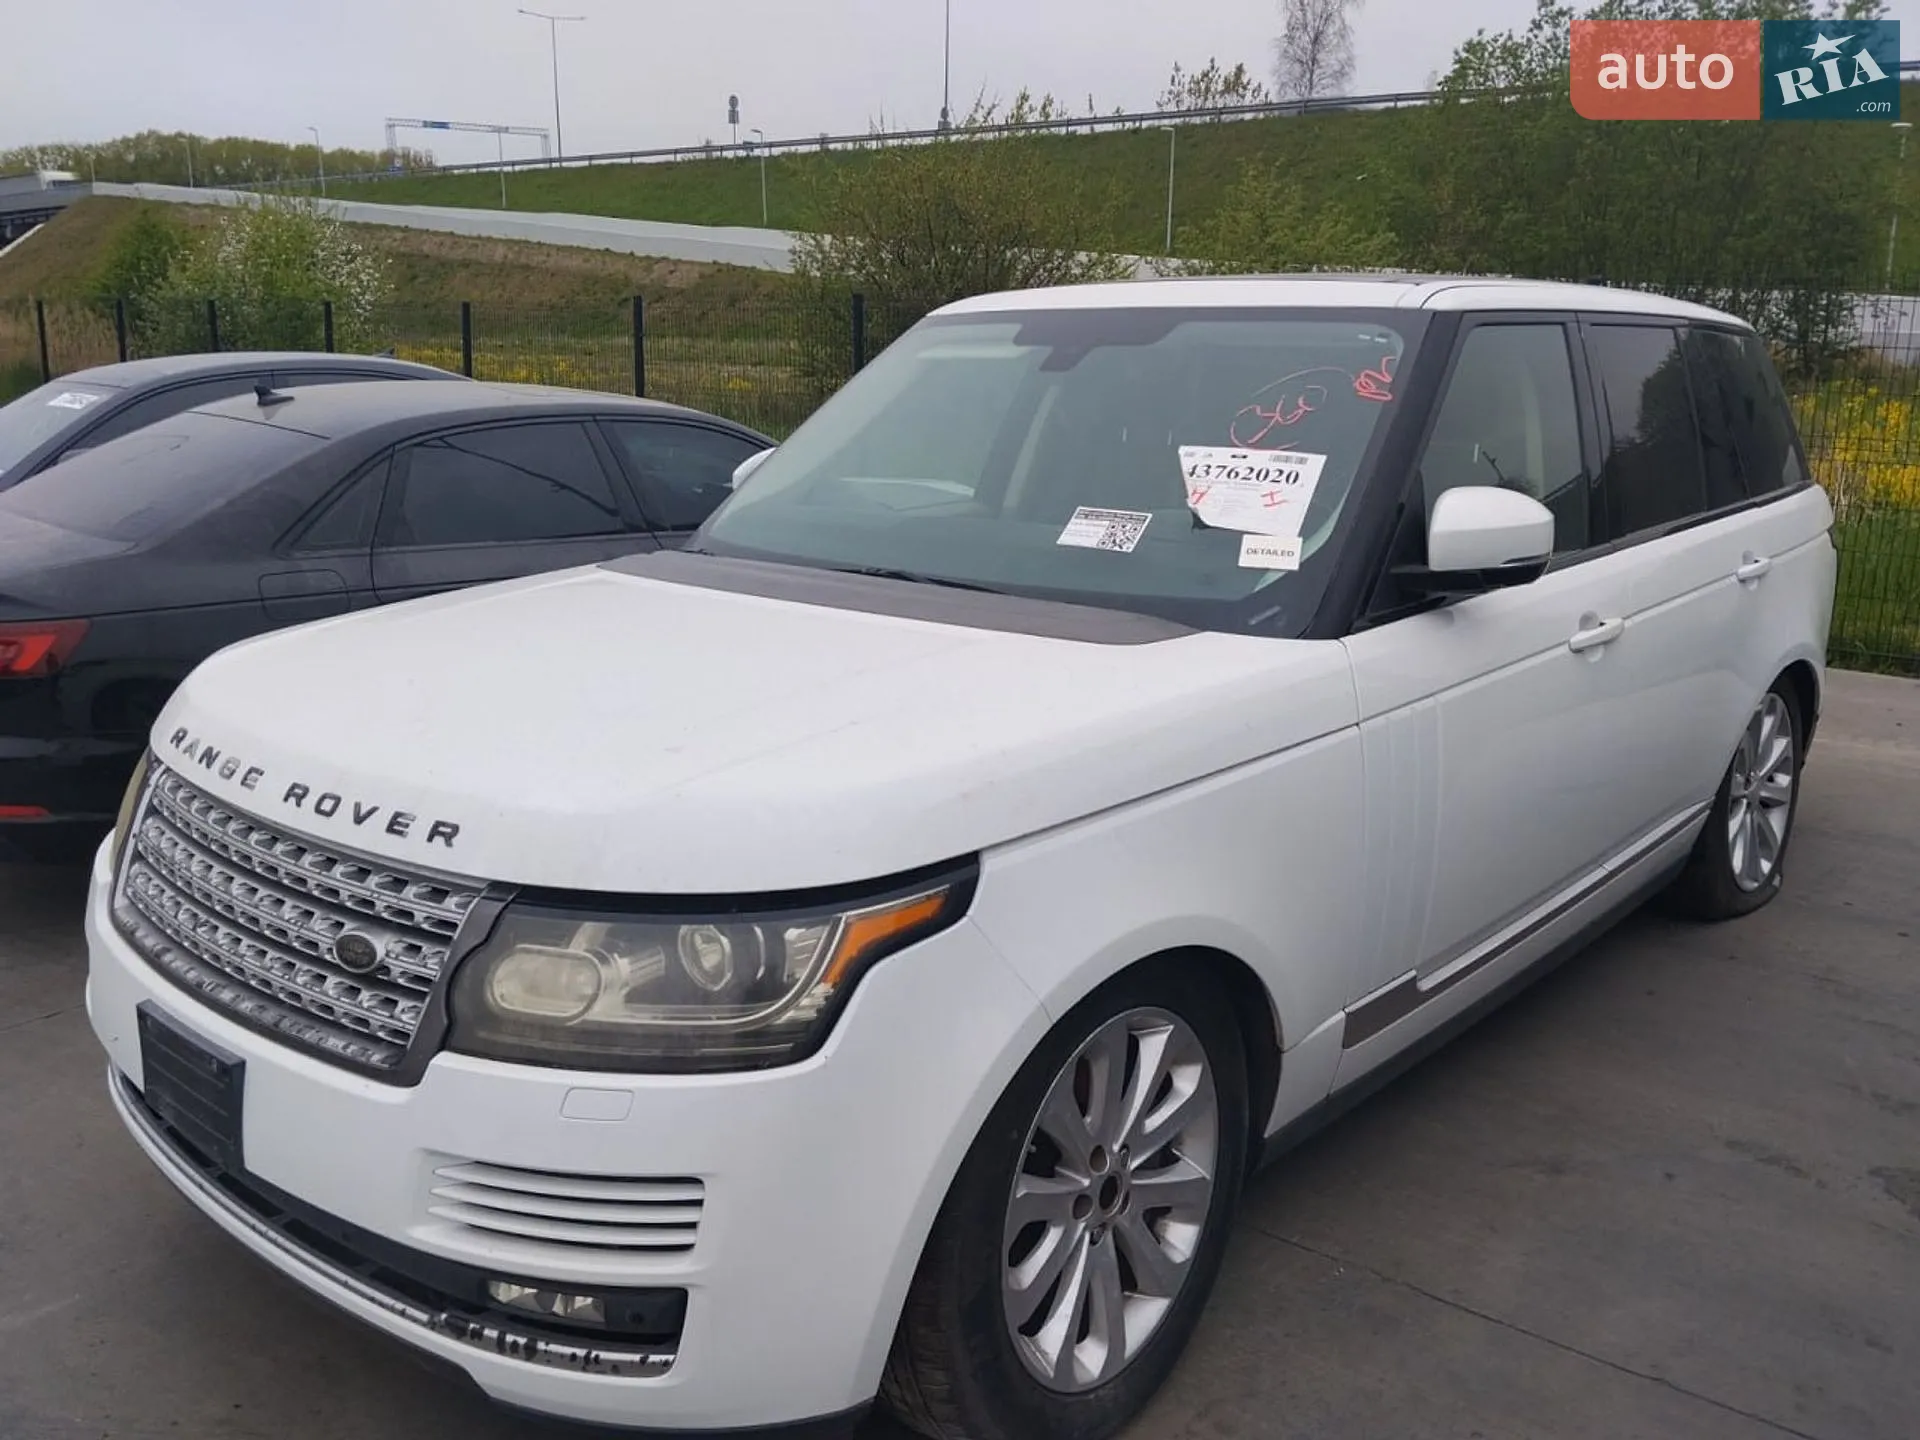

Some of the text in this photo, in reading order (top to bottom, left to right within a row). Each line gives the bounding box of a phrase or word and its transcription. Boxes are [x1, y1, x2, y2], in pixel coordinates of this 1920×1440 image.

[1246, 547, 1295, 558] DETAILED
[169, 726, 460, 848] RANGE ROVER
